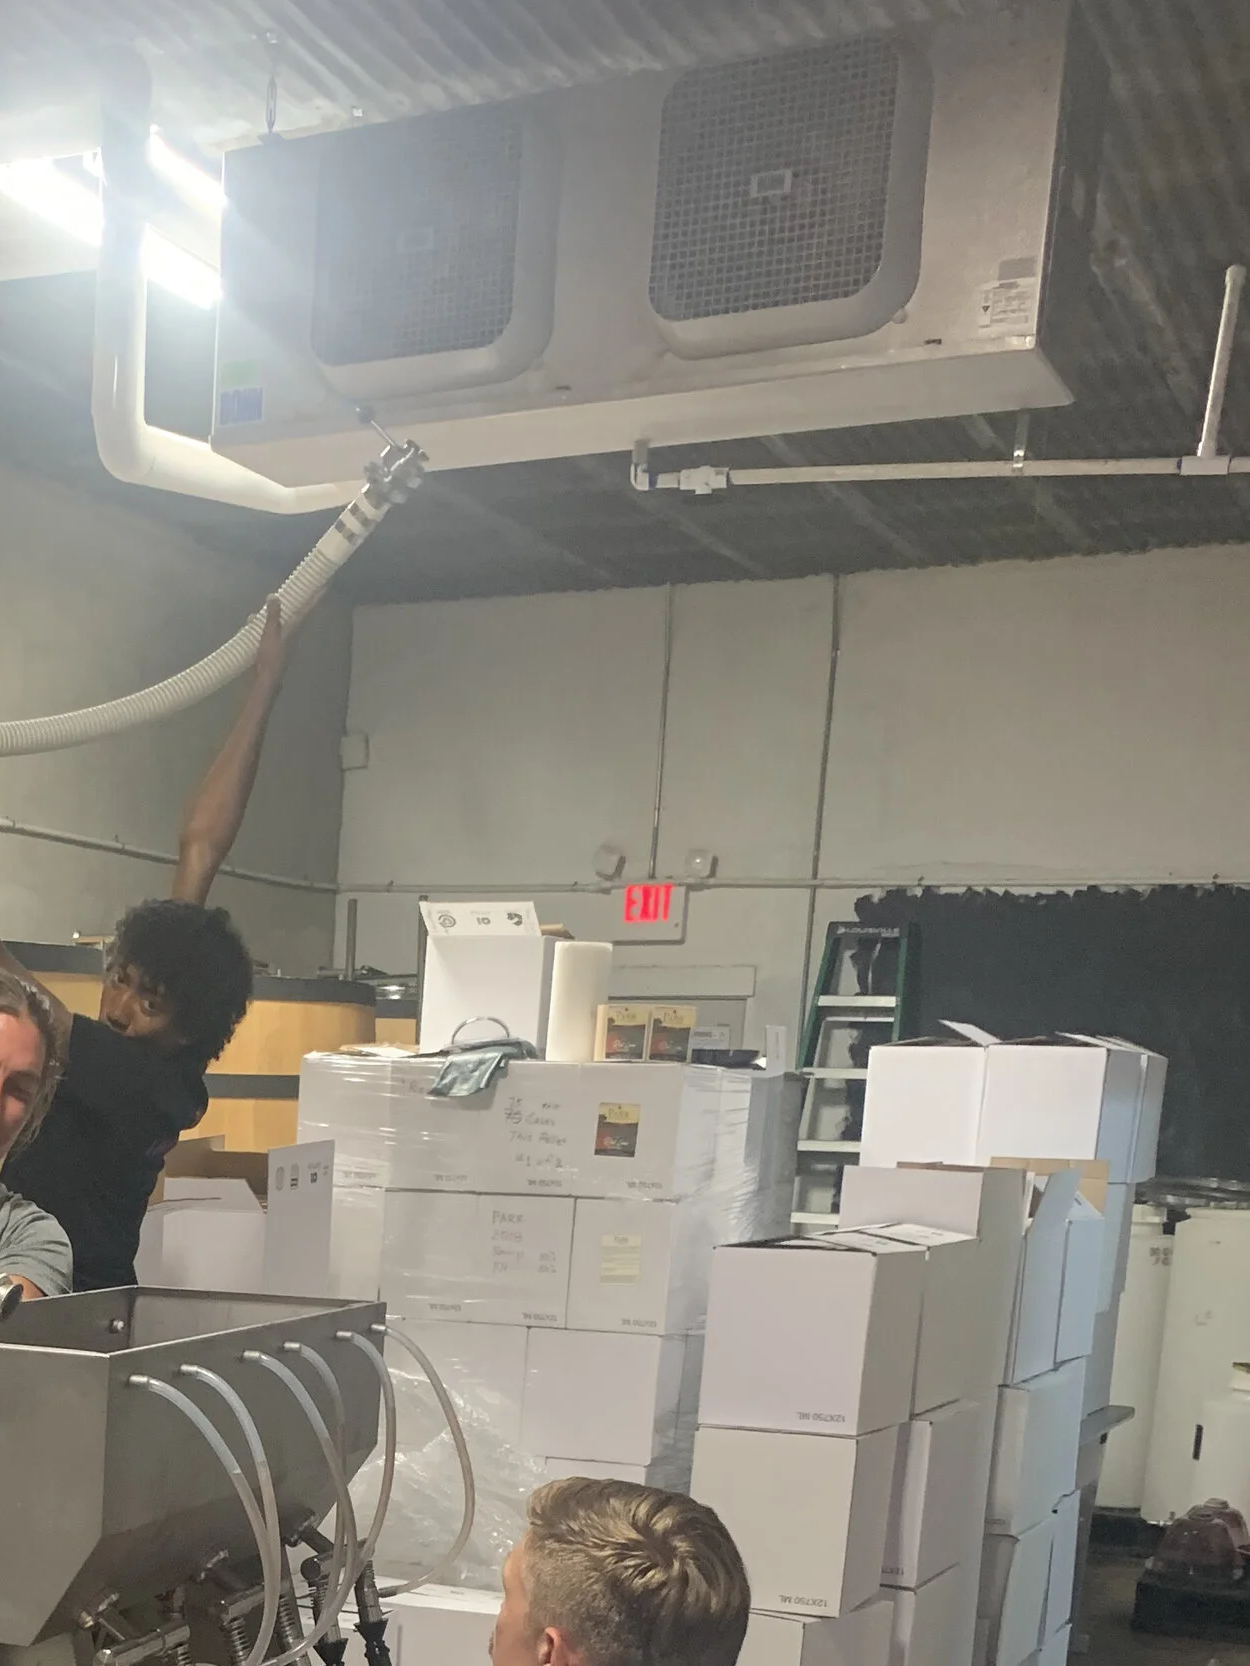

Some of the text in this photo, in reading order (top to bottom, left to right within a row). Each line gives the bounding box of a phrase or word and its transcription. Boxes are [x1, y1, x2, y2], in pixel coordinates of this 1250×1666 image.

[623, 882, 674, 923] EXIT
[795, 1411, 810, 1421] ML
[778, 1594, 792, 1605] ML
